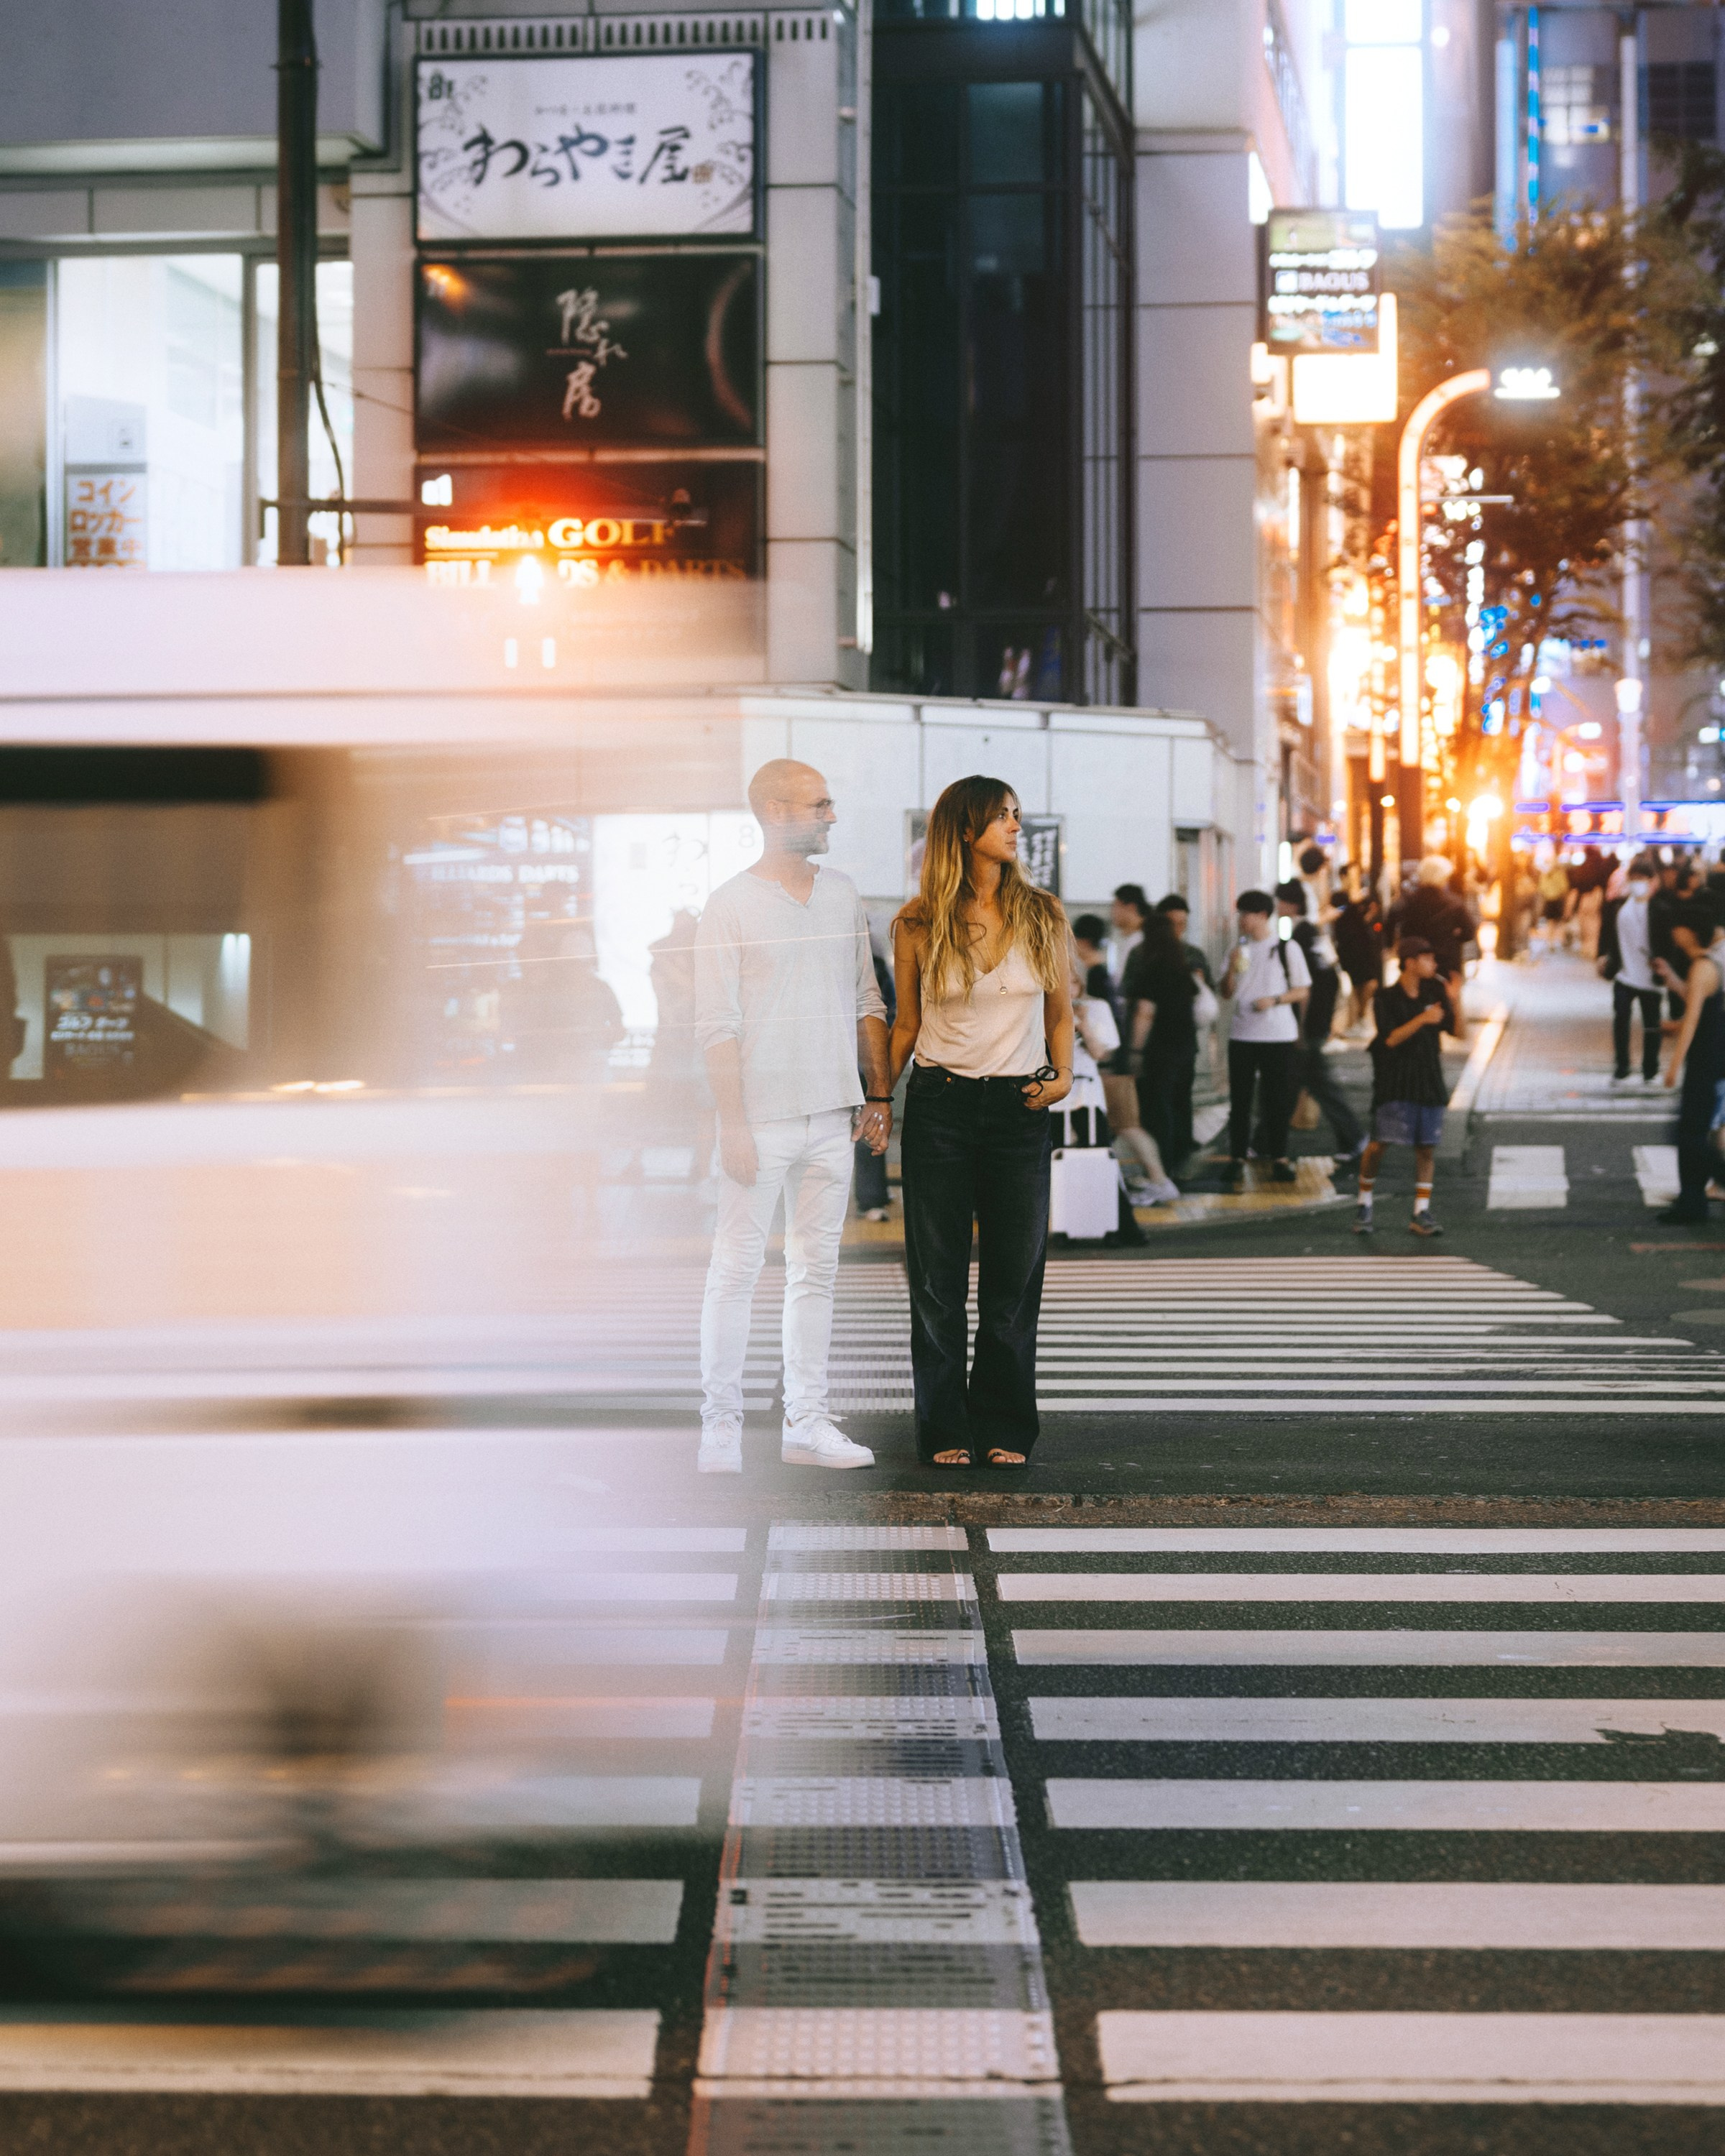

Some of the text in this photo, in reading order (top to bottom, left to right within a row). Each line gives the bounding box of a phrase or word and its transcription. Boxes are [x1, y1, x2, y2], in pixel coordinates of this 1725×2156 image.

[462, 124, 691, 185] わらやき屋
[1297, 271, 1369, 291] BAGUS
[77, 479, 136, 506] コイン
[70, 507, 142, 534] ロッカー
[547, 517, 674, 548] GOLF
[518, 864, 579, 885] DARTS
